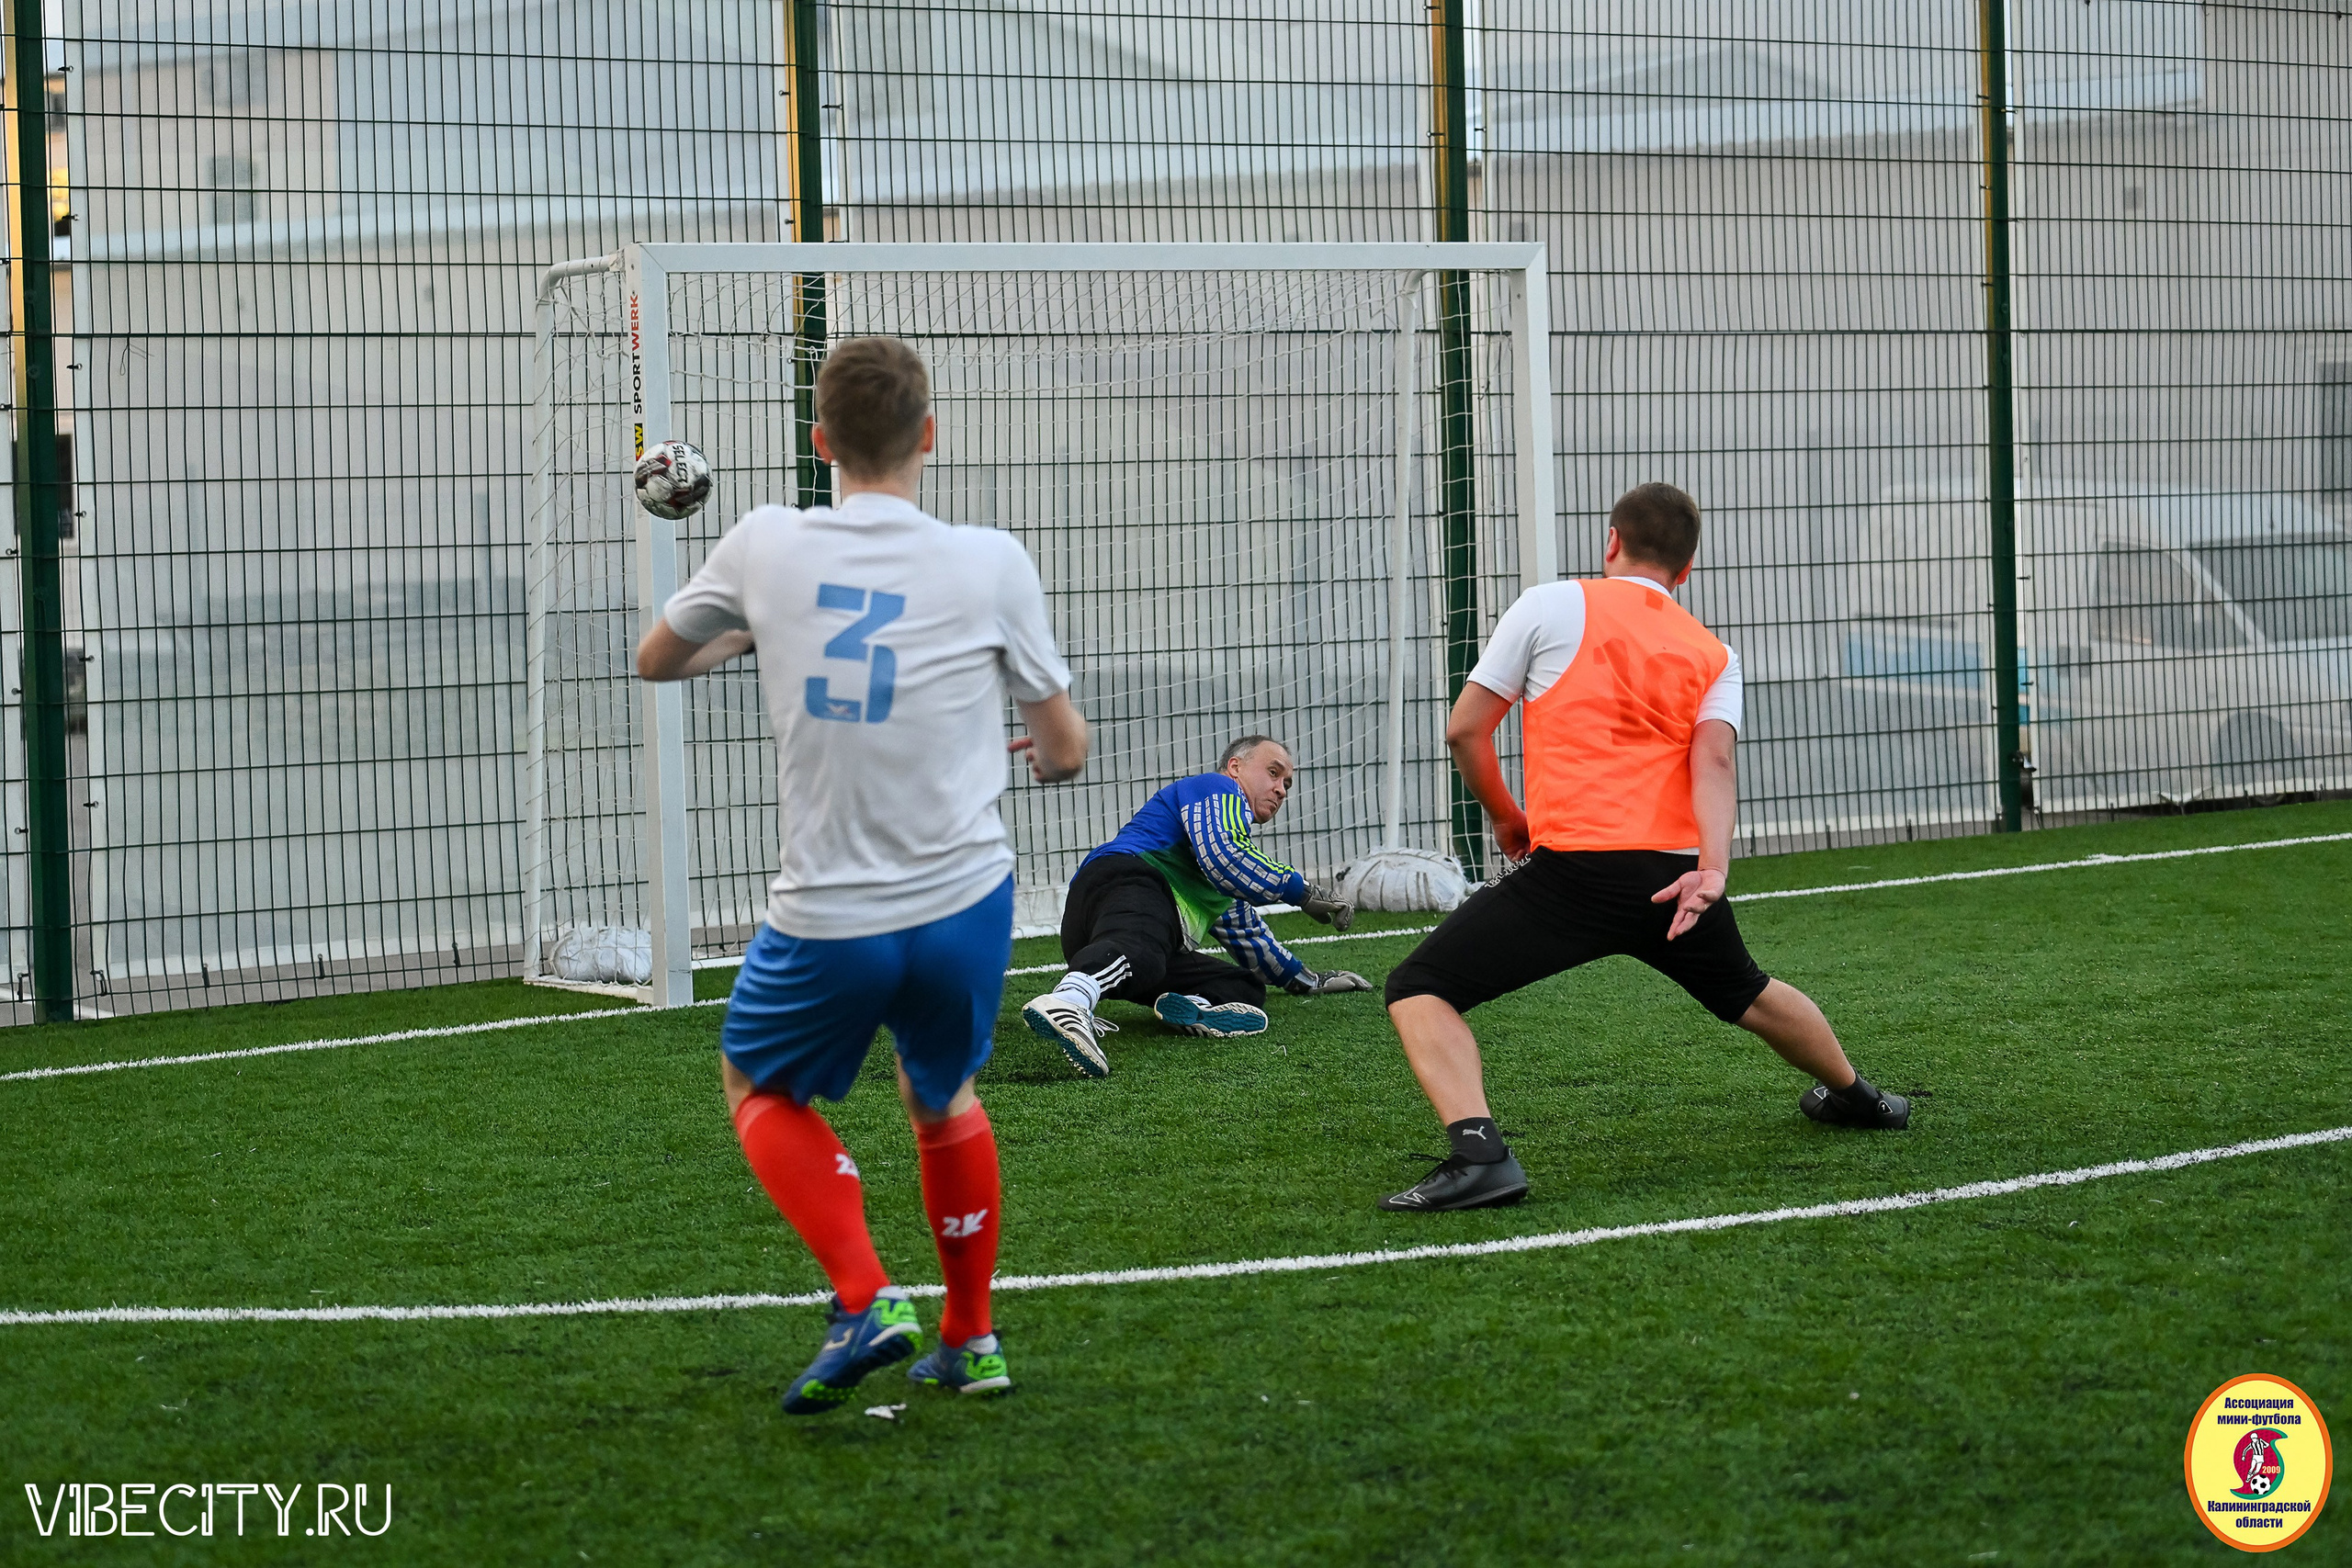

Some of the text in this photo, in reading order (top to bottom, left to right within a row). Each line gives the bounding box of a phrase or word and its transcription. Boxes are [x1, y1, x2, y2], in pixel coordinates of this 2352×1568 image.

[630, 294, 642, 414] SPORTWERK
[673, 445, 688, 484] SELECT
[805, 583, 906, 724] 3
[942, 1208, 989, 1237] 2K
